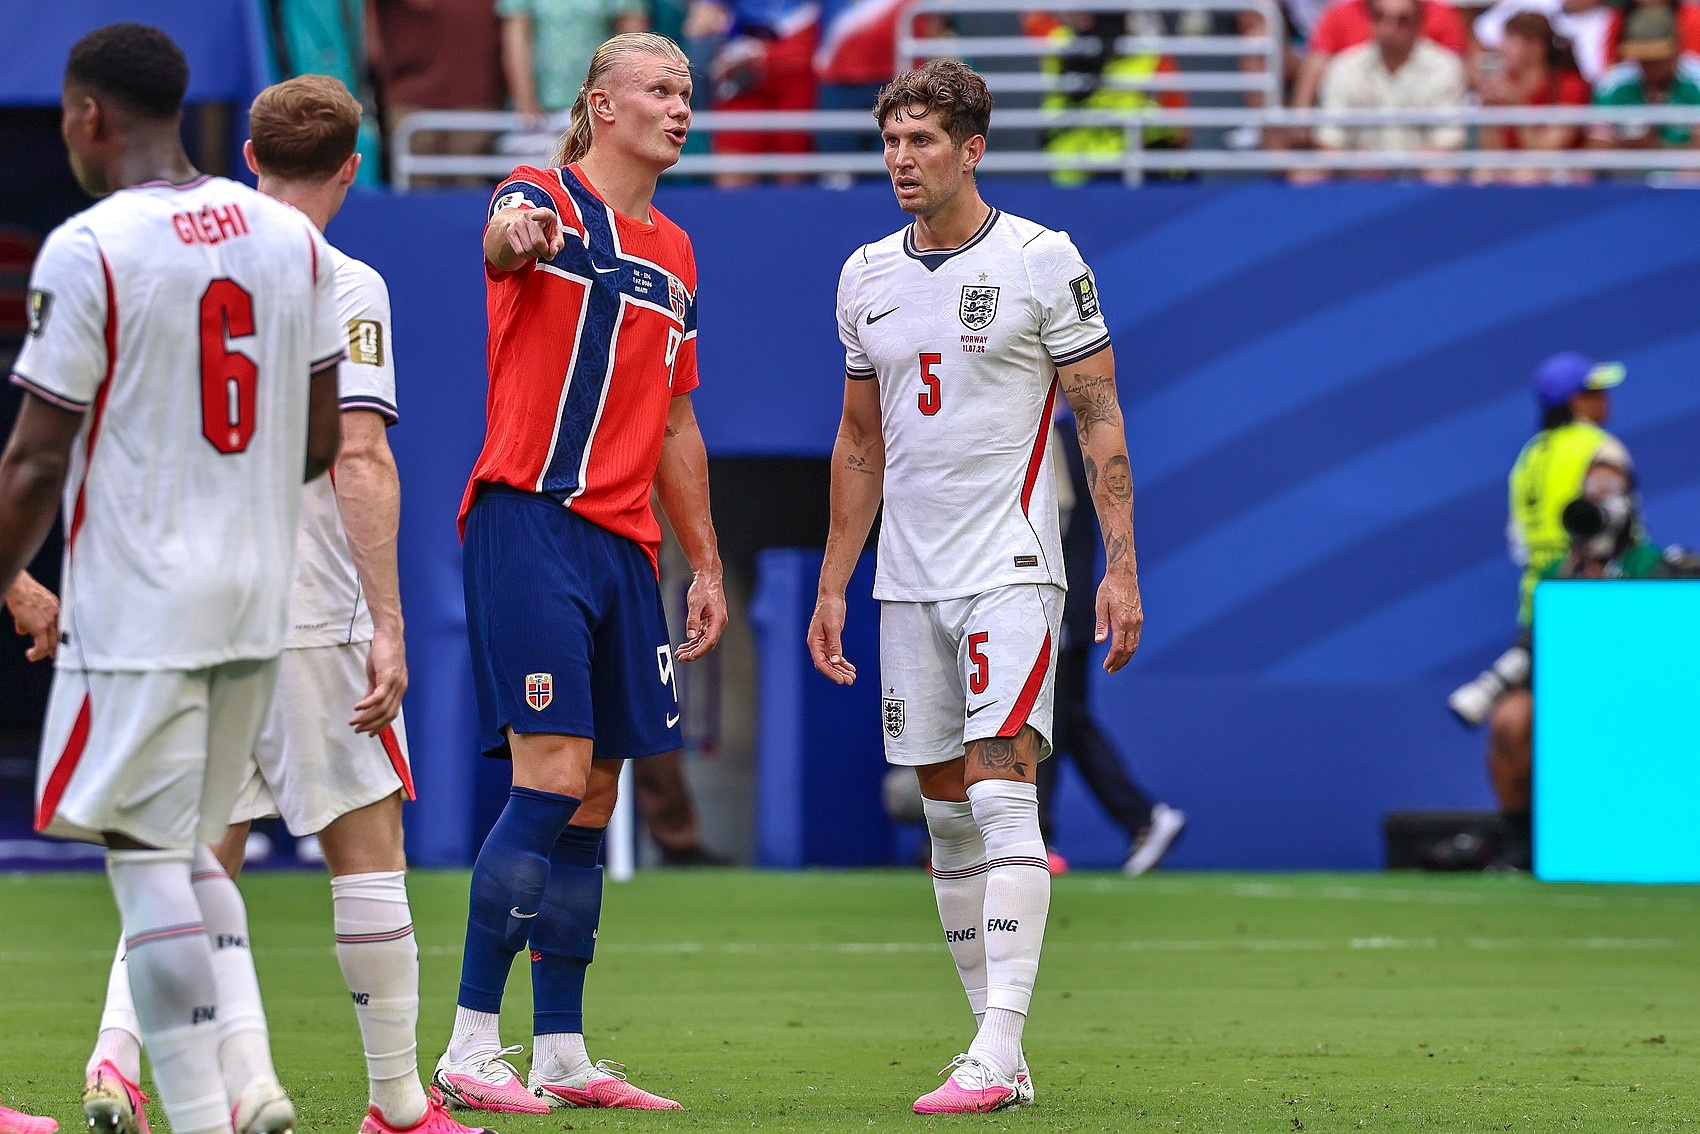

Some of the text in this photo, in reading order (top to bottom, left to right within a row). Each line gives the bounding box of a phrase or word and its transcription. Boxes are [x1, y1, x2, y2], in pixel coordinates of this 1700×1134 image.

[199, 277, 258, 454] 6
[664, 325, 683, 388] 9
[960, 334, 988, 344] NORWAY
[918, 352, 942, 416] 5
[656, 643, 678, 703] 9
[967, 631, 990, 695] 5
[945, 927, 977, 943] ENG
[987, 918, 1019, 933] ENG
[350, 991, 370, 1005] NG
